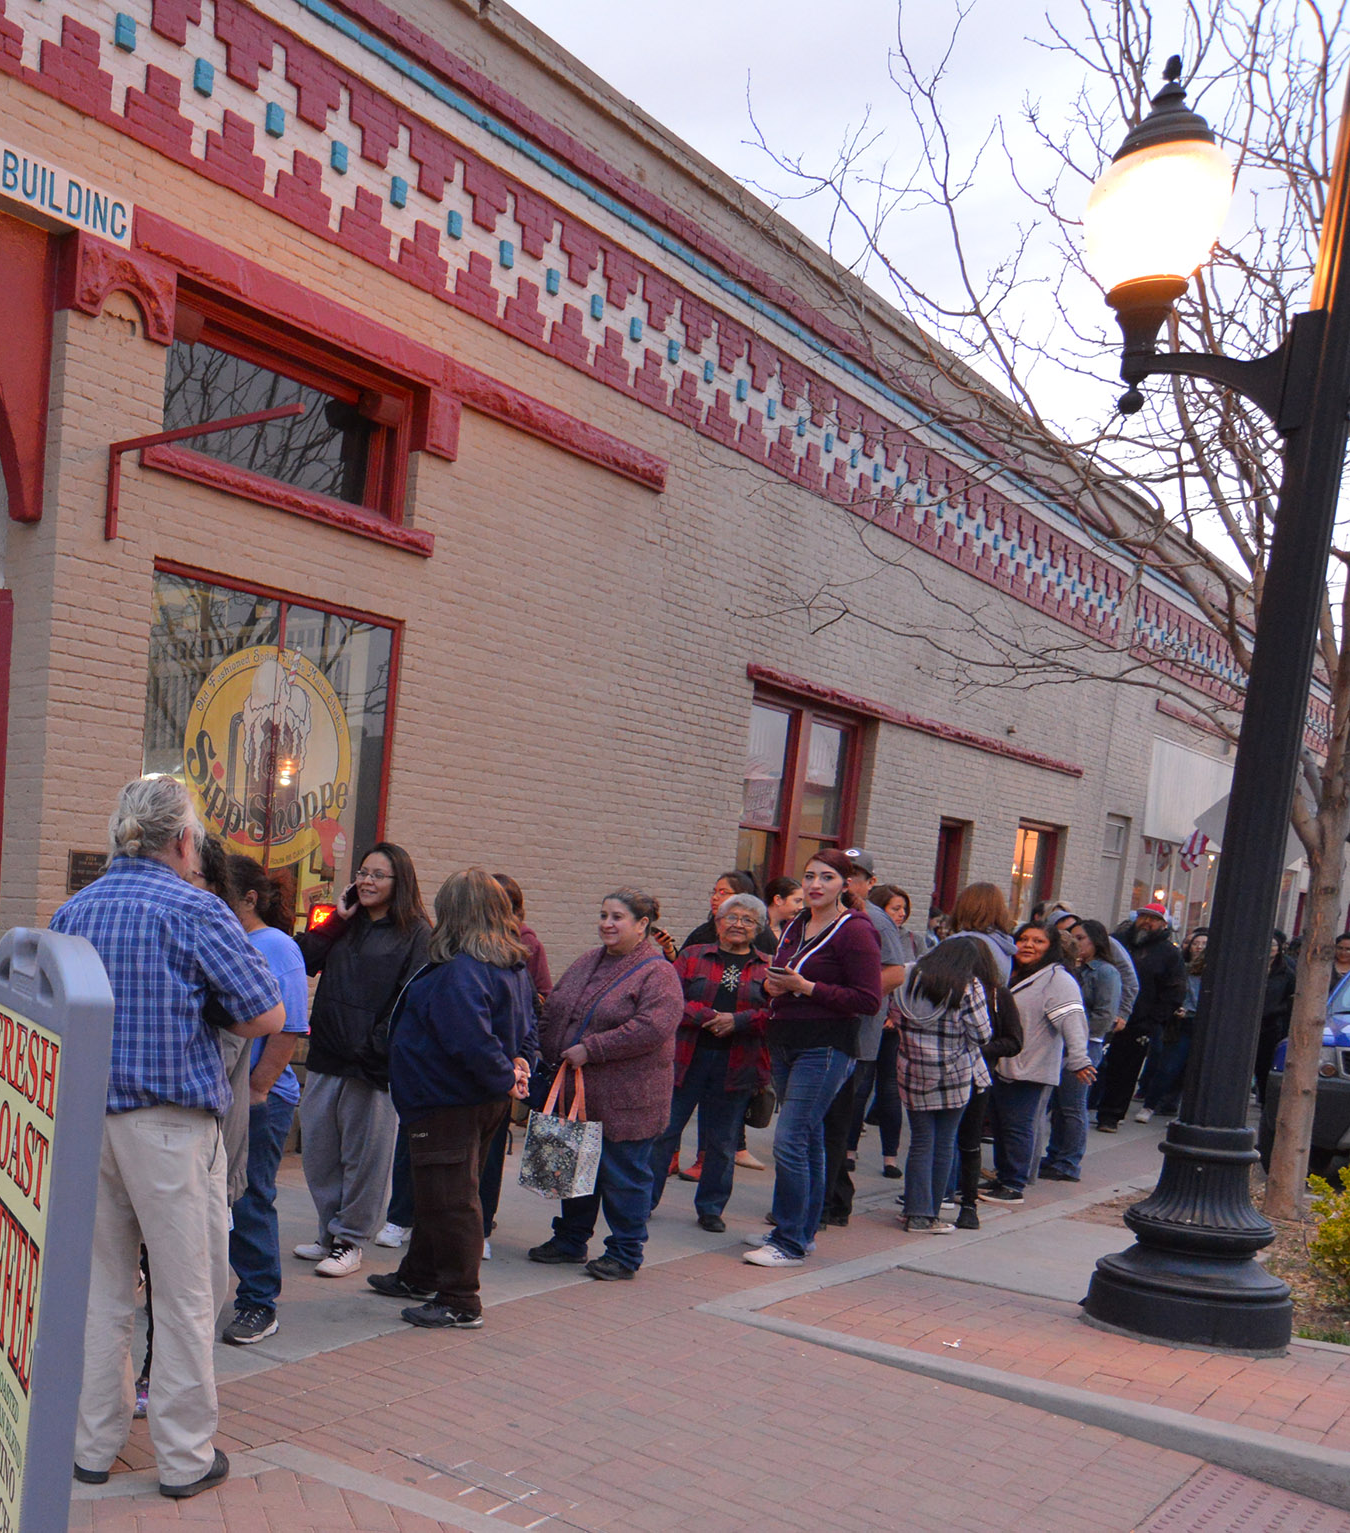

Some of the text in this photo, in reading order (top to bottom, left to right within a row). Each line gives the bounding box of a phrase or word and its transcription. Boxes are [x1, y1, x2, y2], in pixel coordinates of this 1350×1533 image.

[2, 149, 128, 241] BUILDING
[195, 690, 211, 712] Old
[207, 654, 251, 688] Fashioned
[186, 729, 349, 843] Sipp Shoppe
